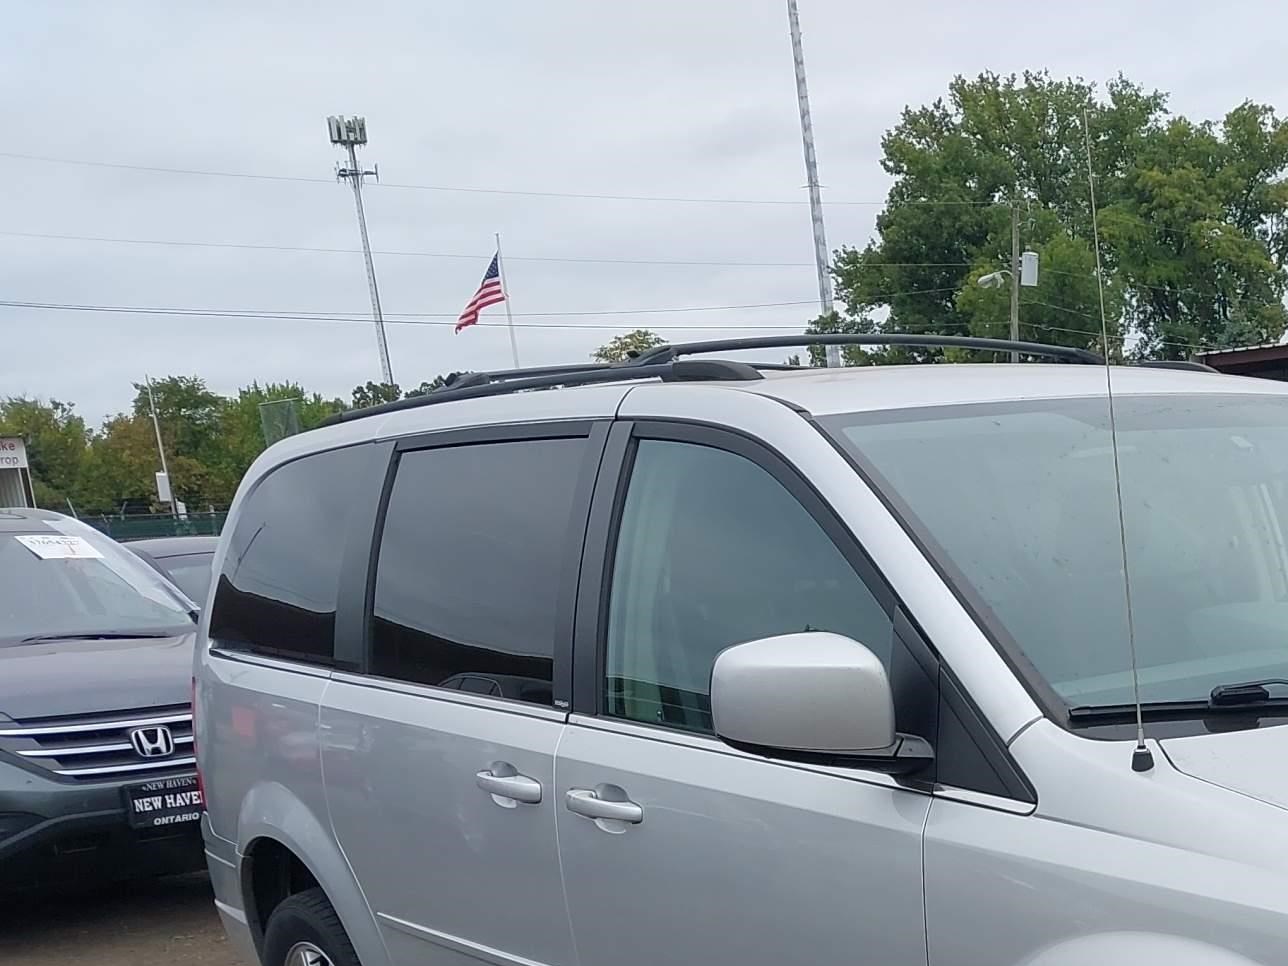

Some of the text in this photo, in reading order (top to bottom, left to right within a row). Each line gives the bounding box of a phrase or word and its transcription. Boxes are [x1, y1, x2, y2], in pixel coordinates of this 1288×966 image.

[146, 777, 192, 791] NEW HAVEN
[134, 796, 162, 812] NEW
[154, 812, 200, 825] ONTARIO
